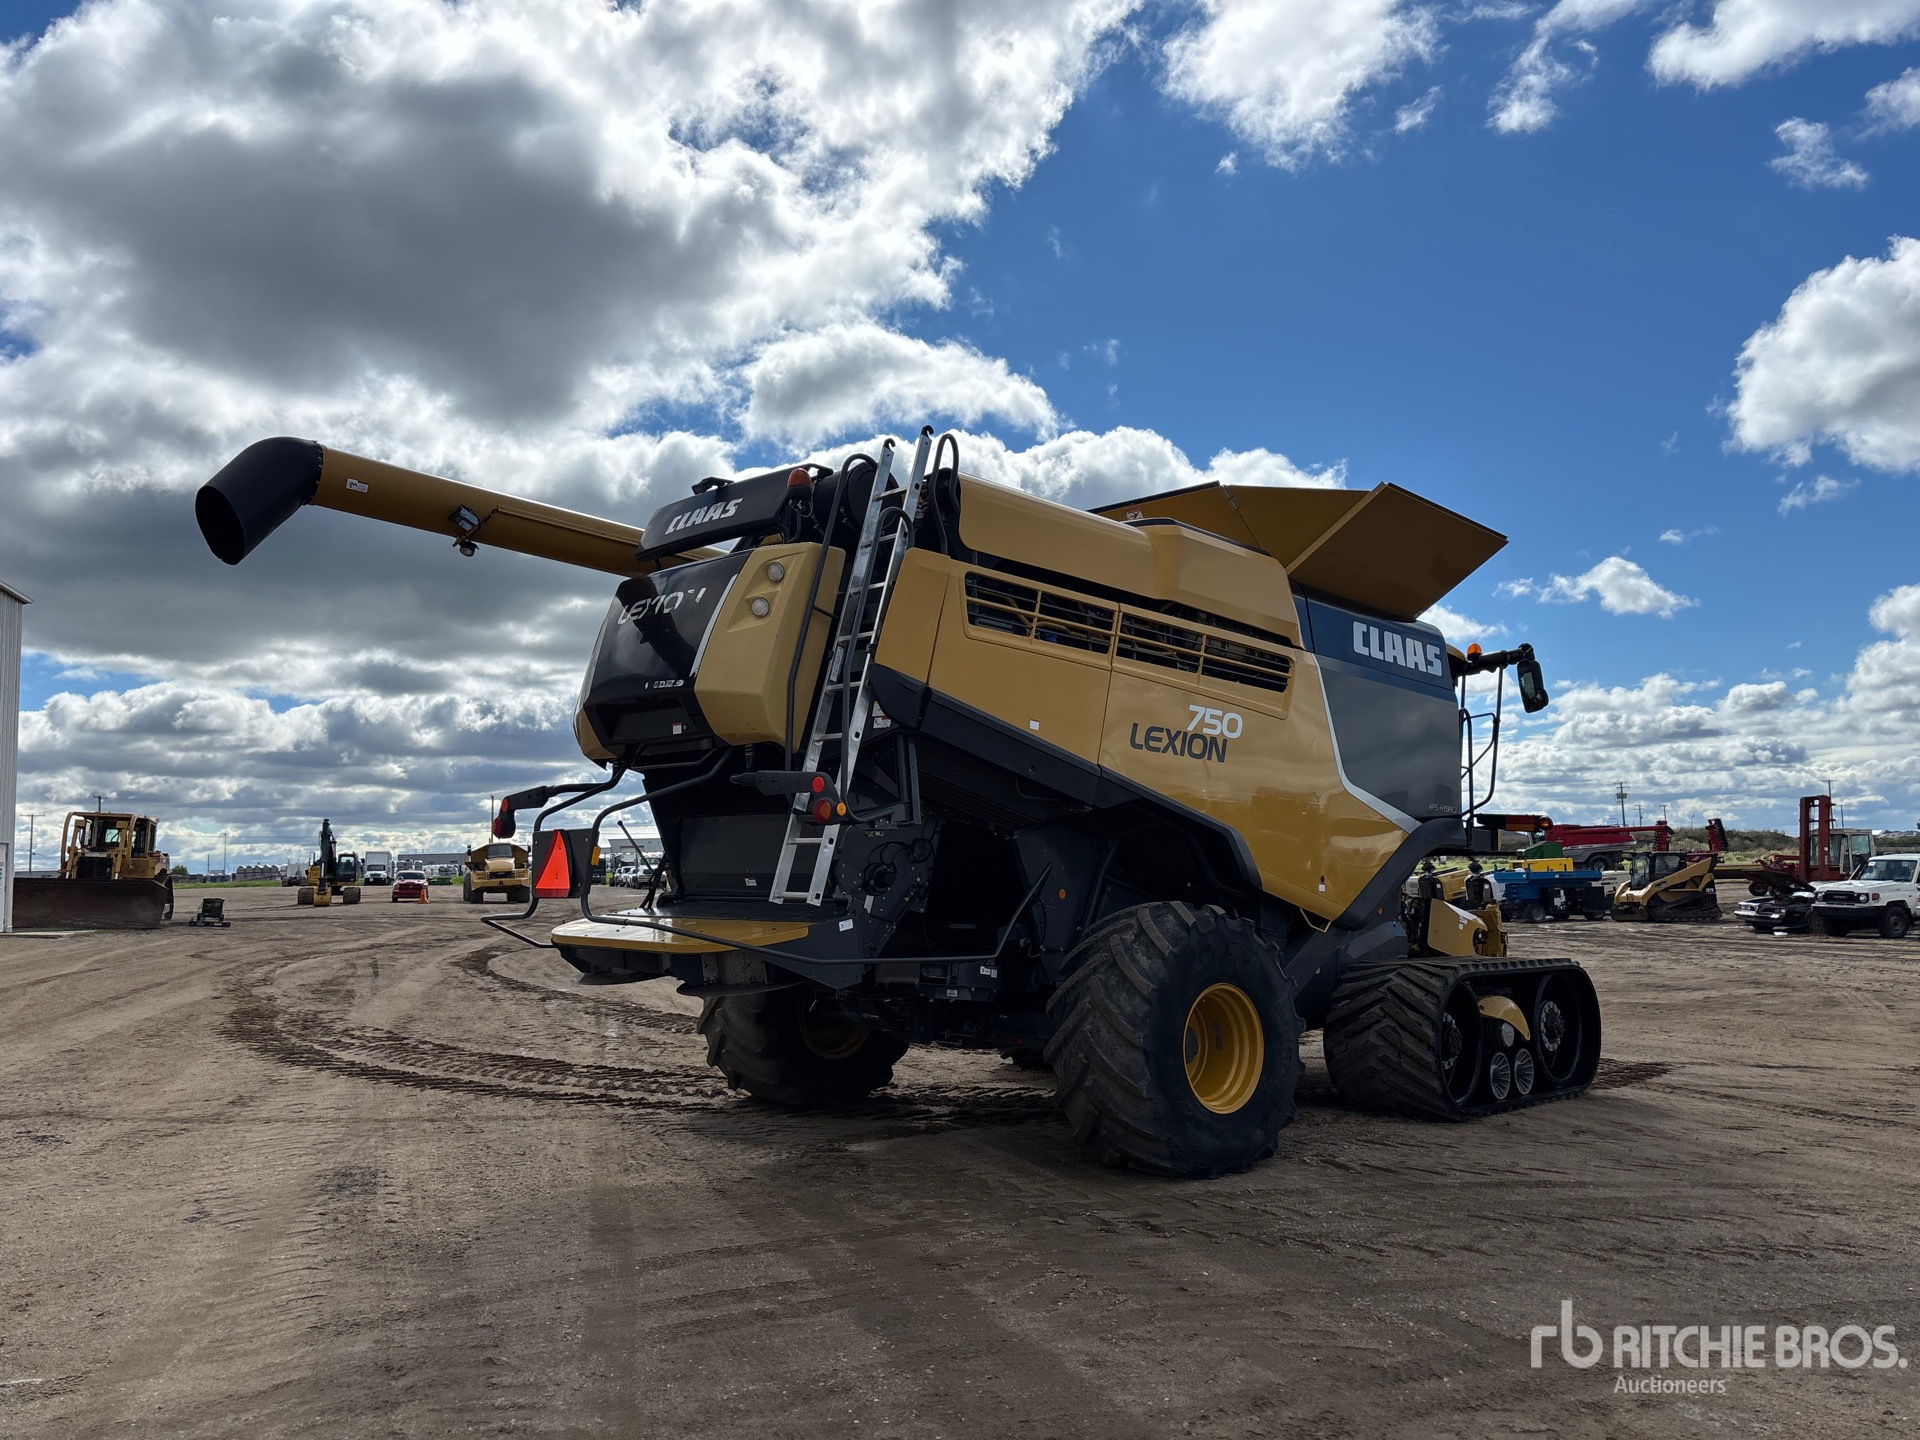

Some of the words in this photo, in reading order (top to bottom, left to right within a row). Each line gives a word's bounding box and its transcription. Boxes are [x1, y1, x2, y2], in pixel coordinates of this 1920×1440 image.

[664, 497, 744, 535] CLAAS
[1352, 620, 1443, 678] CLAAS
[1186, 704, 1243, 739] 750
[1129, 721, 1229, 763] LEXION
